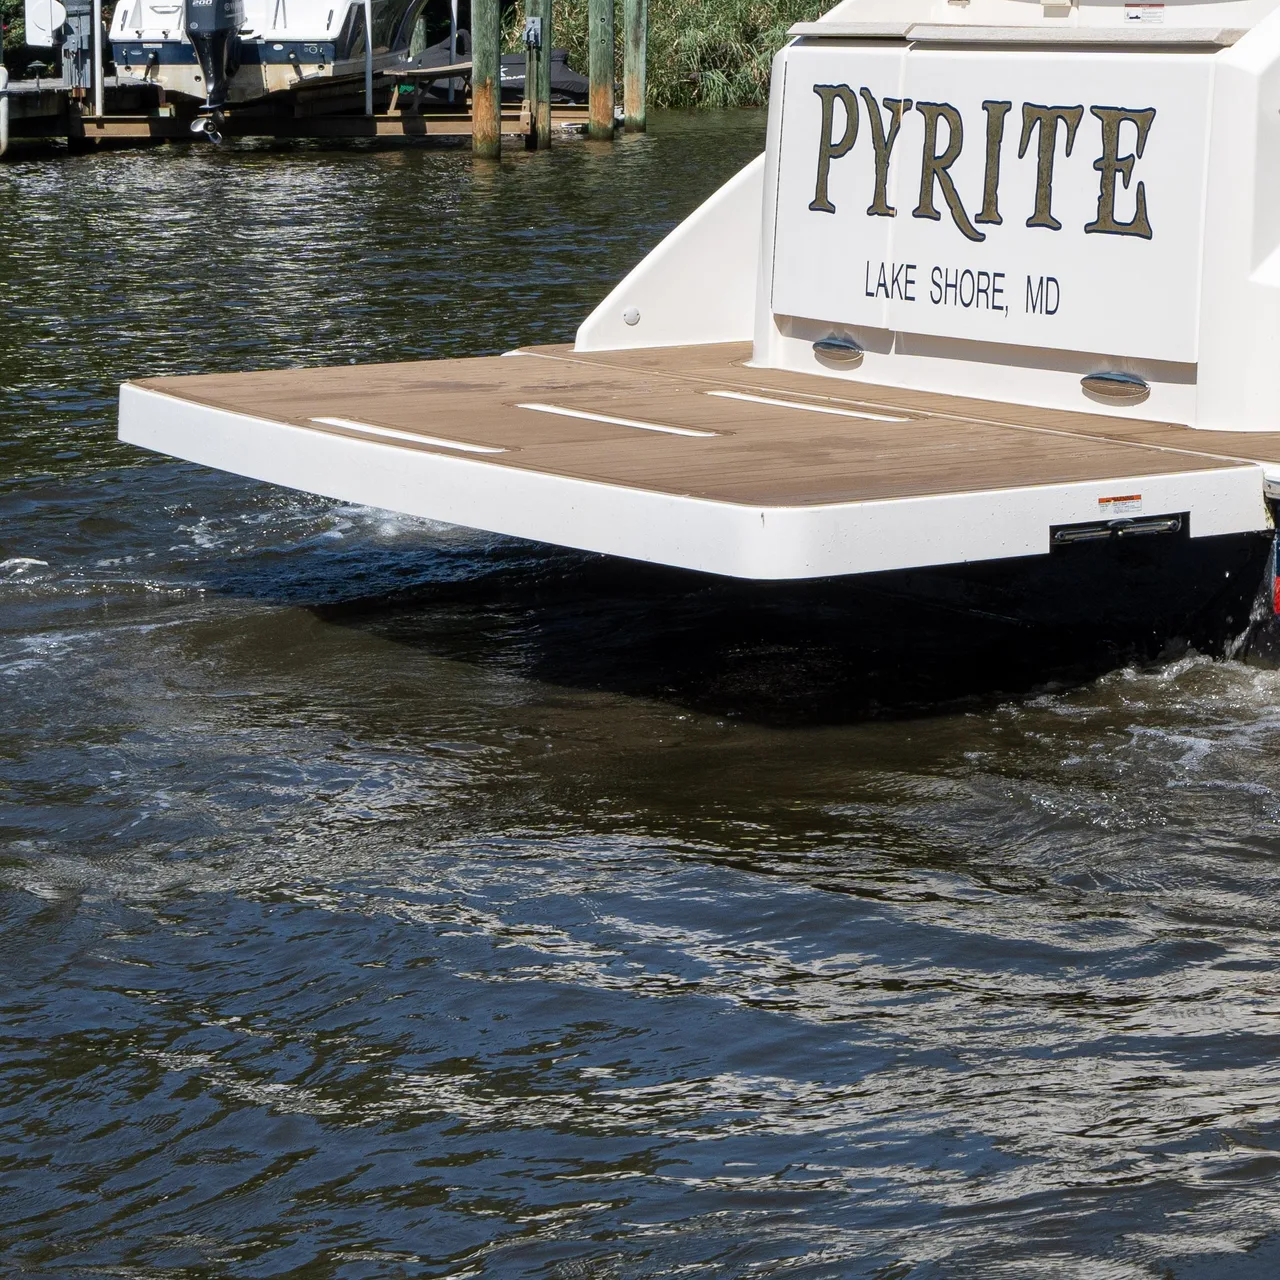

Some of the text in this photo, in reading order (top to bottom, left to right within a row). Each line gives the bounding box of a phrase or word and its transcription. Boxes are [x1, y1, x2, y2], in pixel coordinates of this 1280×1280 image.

[808, 83, 1157, 242] PYRITE
[865, 260, 1060, 318] LAKE SHORE, MD
